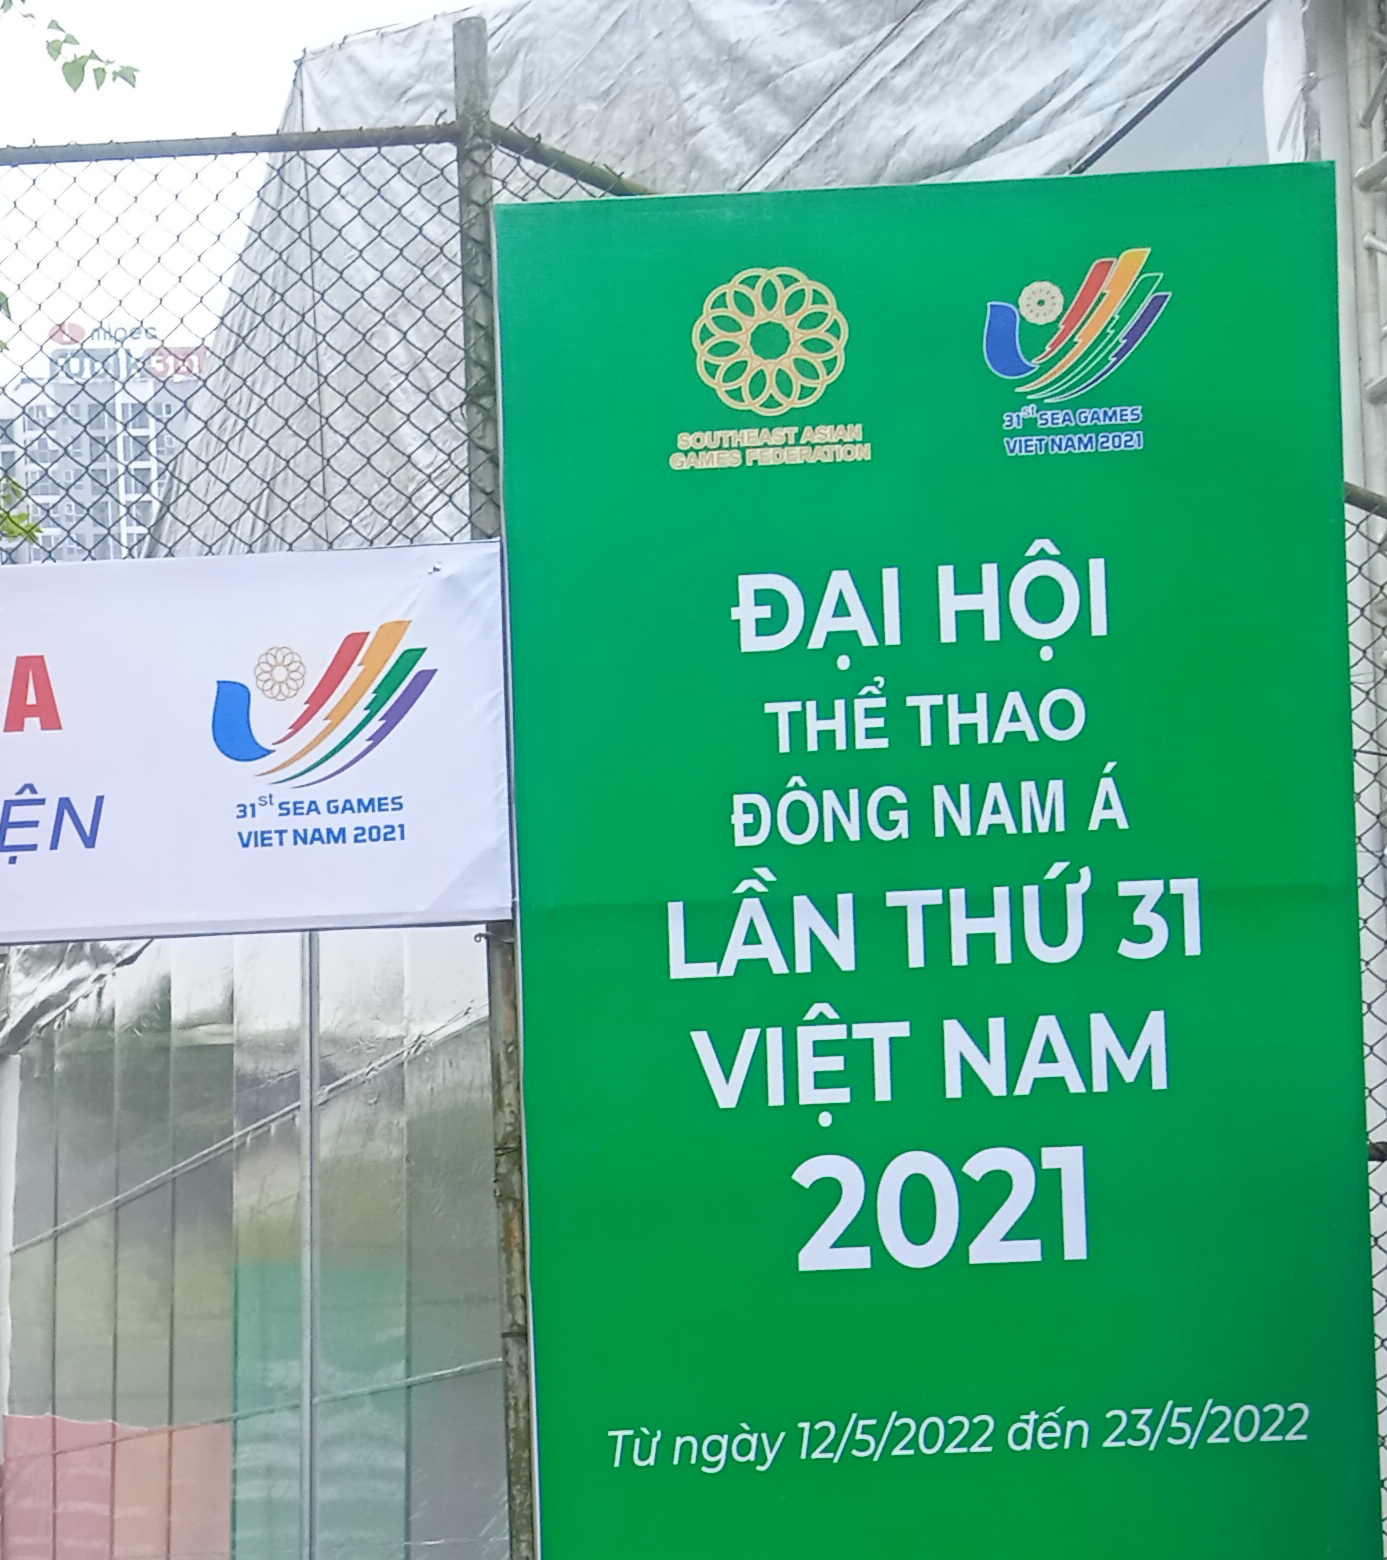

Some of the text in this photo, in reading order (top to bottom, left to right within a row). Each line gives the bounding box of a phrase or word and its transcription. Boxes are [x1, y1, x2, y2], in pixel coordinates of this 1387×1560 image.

[678, 424, 863, 449] SOUTHEAST ASIAN
[1005, 431, 1144, 456] VIET NAM 2021
[1038, 409, 1074, 427] SEA
[1076, 405, 1142, 424] GAMES
[670, 443, 870, 470] GAMES FEDERATION
[731, 539, 1108, 671] ĐẠI HỘI
[764, 677, 1086, 754] THỂ THAO
[238, 824, 405, 848] VIET NAM 2021
[278, 800, 321, 817] SEA
[327, 796, 404, 814] GAMES
[731, 761, 1129, 847] ĐÔNG NAM Á
[667, 861, 1203, 980] LẦN THỨ 31
[690, 1002, 1168, 1128] VIỆT NAM
[791, 1144, 1088, 1271] 2021
[608, 1399, 1310, 1473] Từ ngày 12/5/2022 đến 23/5/2022
